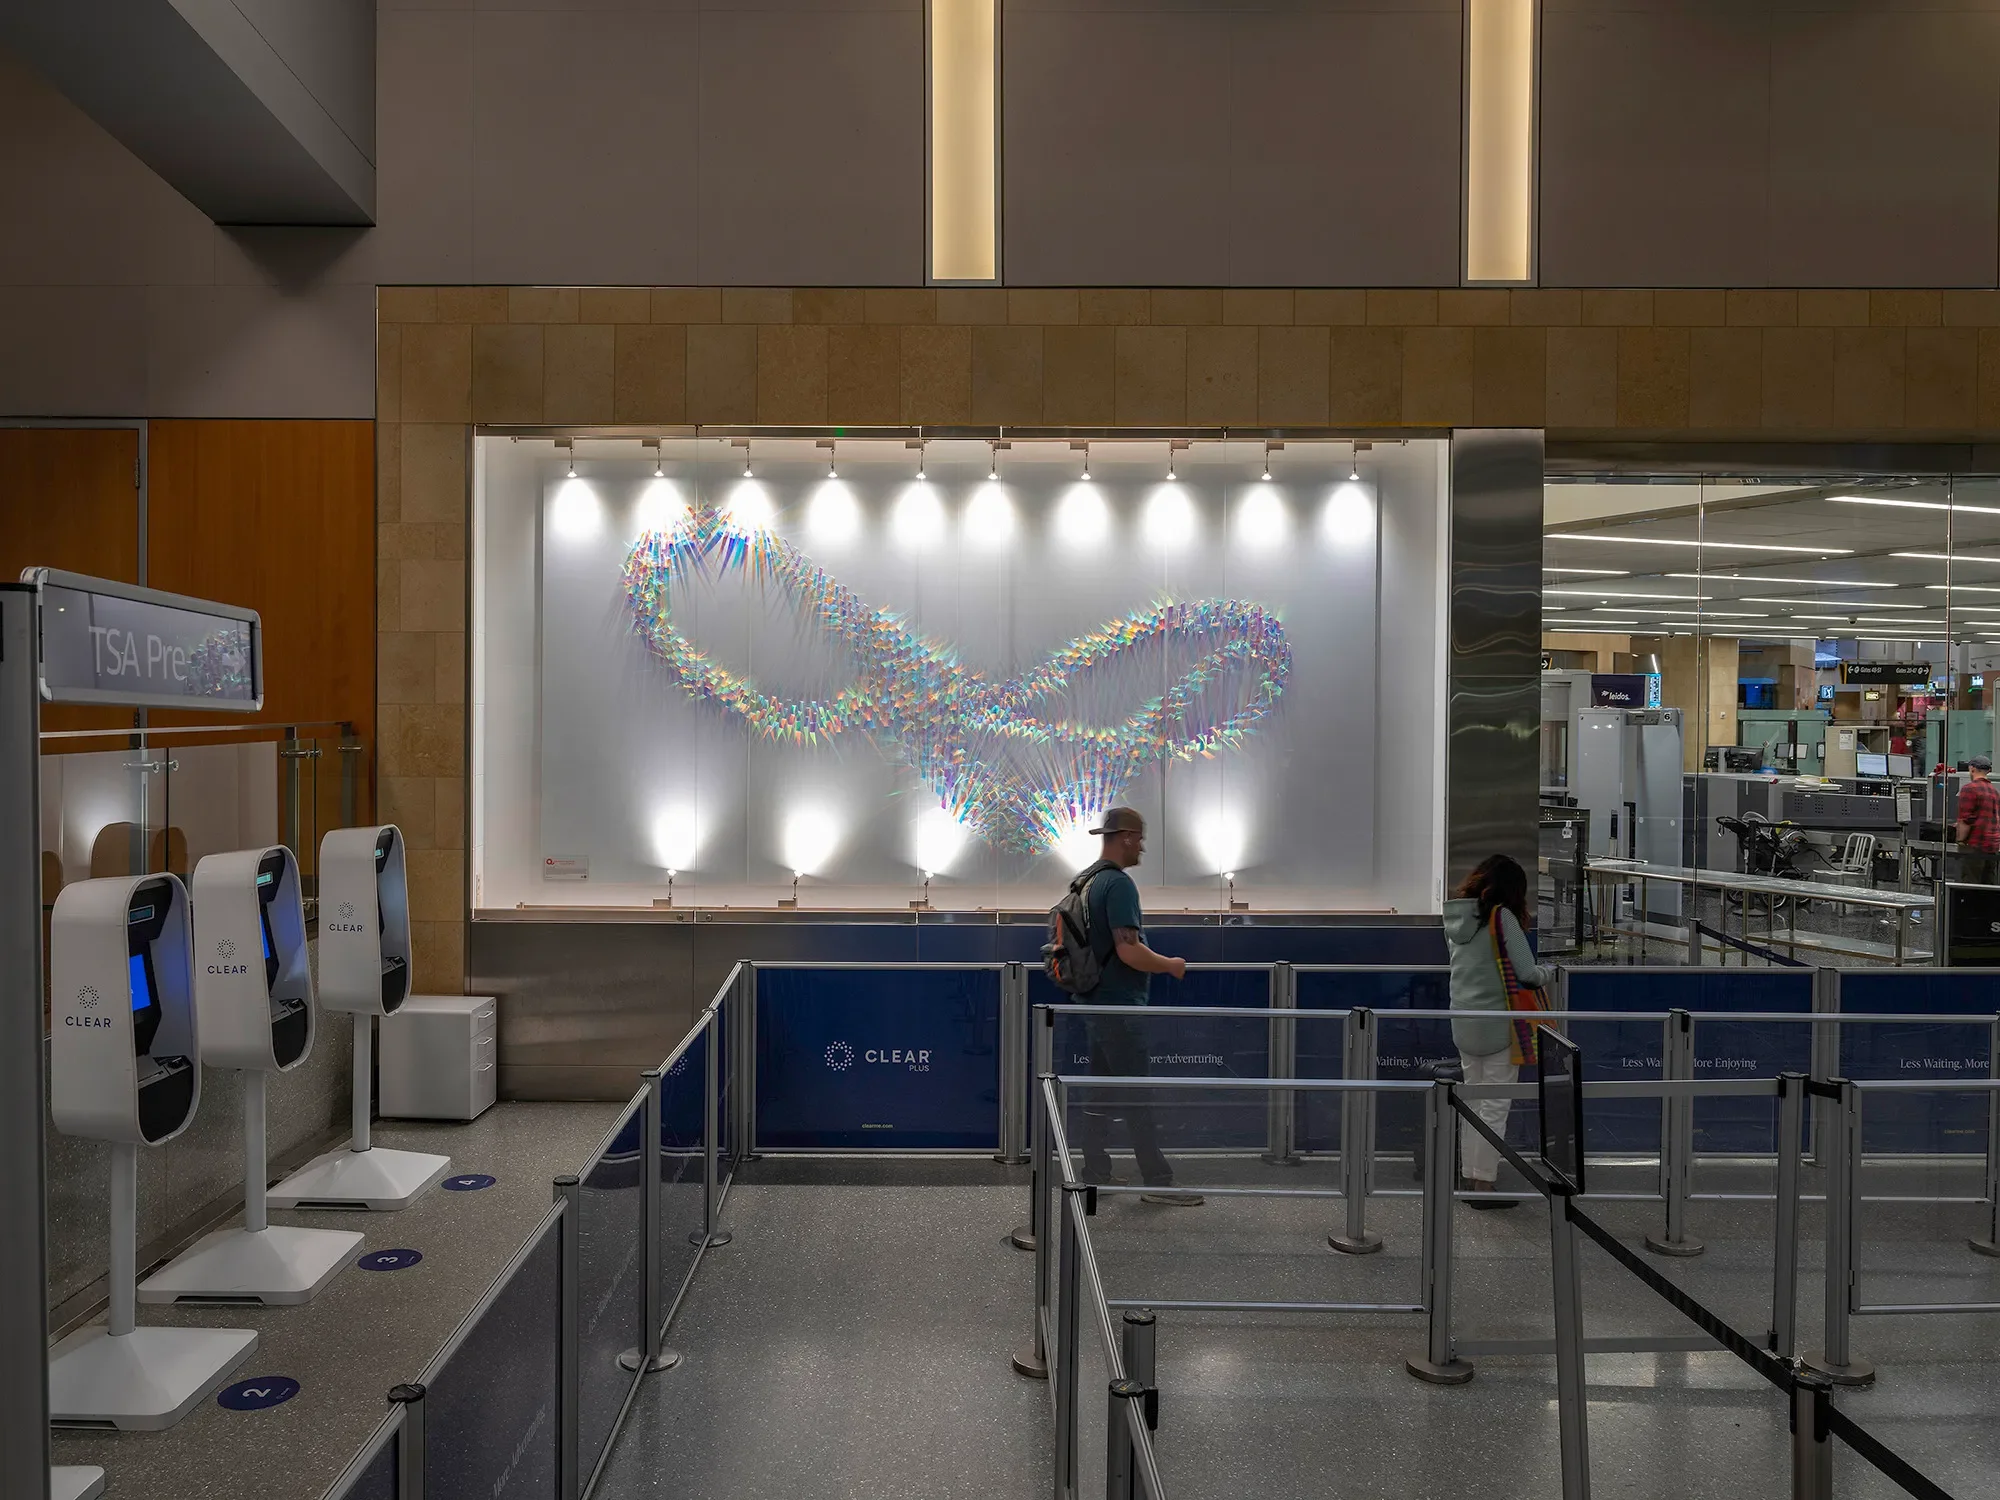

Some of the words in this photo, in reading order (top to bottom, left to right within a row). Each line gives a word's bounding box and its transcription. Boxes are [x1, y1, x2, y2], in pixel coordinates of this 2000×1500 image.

[88, 626, 141, 678] TSA
[329, 923, 363, 932] CLEAR
[207, 965, 247, 974] CLEAR
[65, 1016, 112, 1028] CLEAR
[865, 1049, 930, 1063] CLEAR
[1073, 1053, 1090, 1064] Les
[1164, 1053, 1224, 1066] Adventuring
[909, 1064, 930, 1072] PLUS
[1622, 1057, 1643, 1068] Less
[1715, 1057, 1757, 1071] Enjoying
[1900, 1058, 1921, 1069] Less
[1923, 1058, 1963, 1071] Waiting,
[1965, 1058, 1990, 1069] More
[376, 1256, 399, 1264] 3
[241, 1388, 272, 1398] 2
